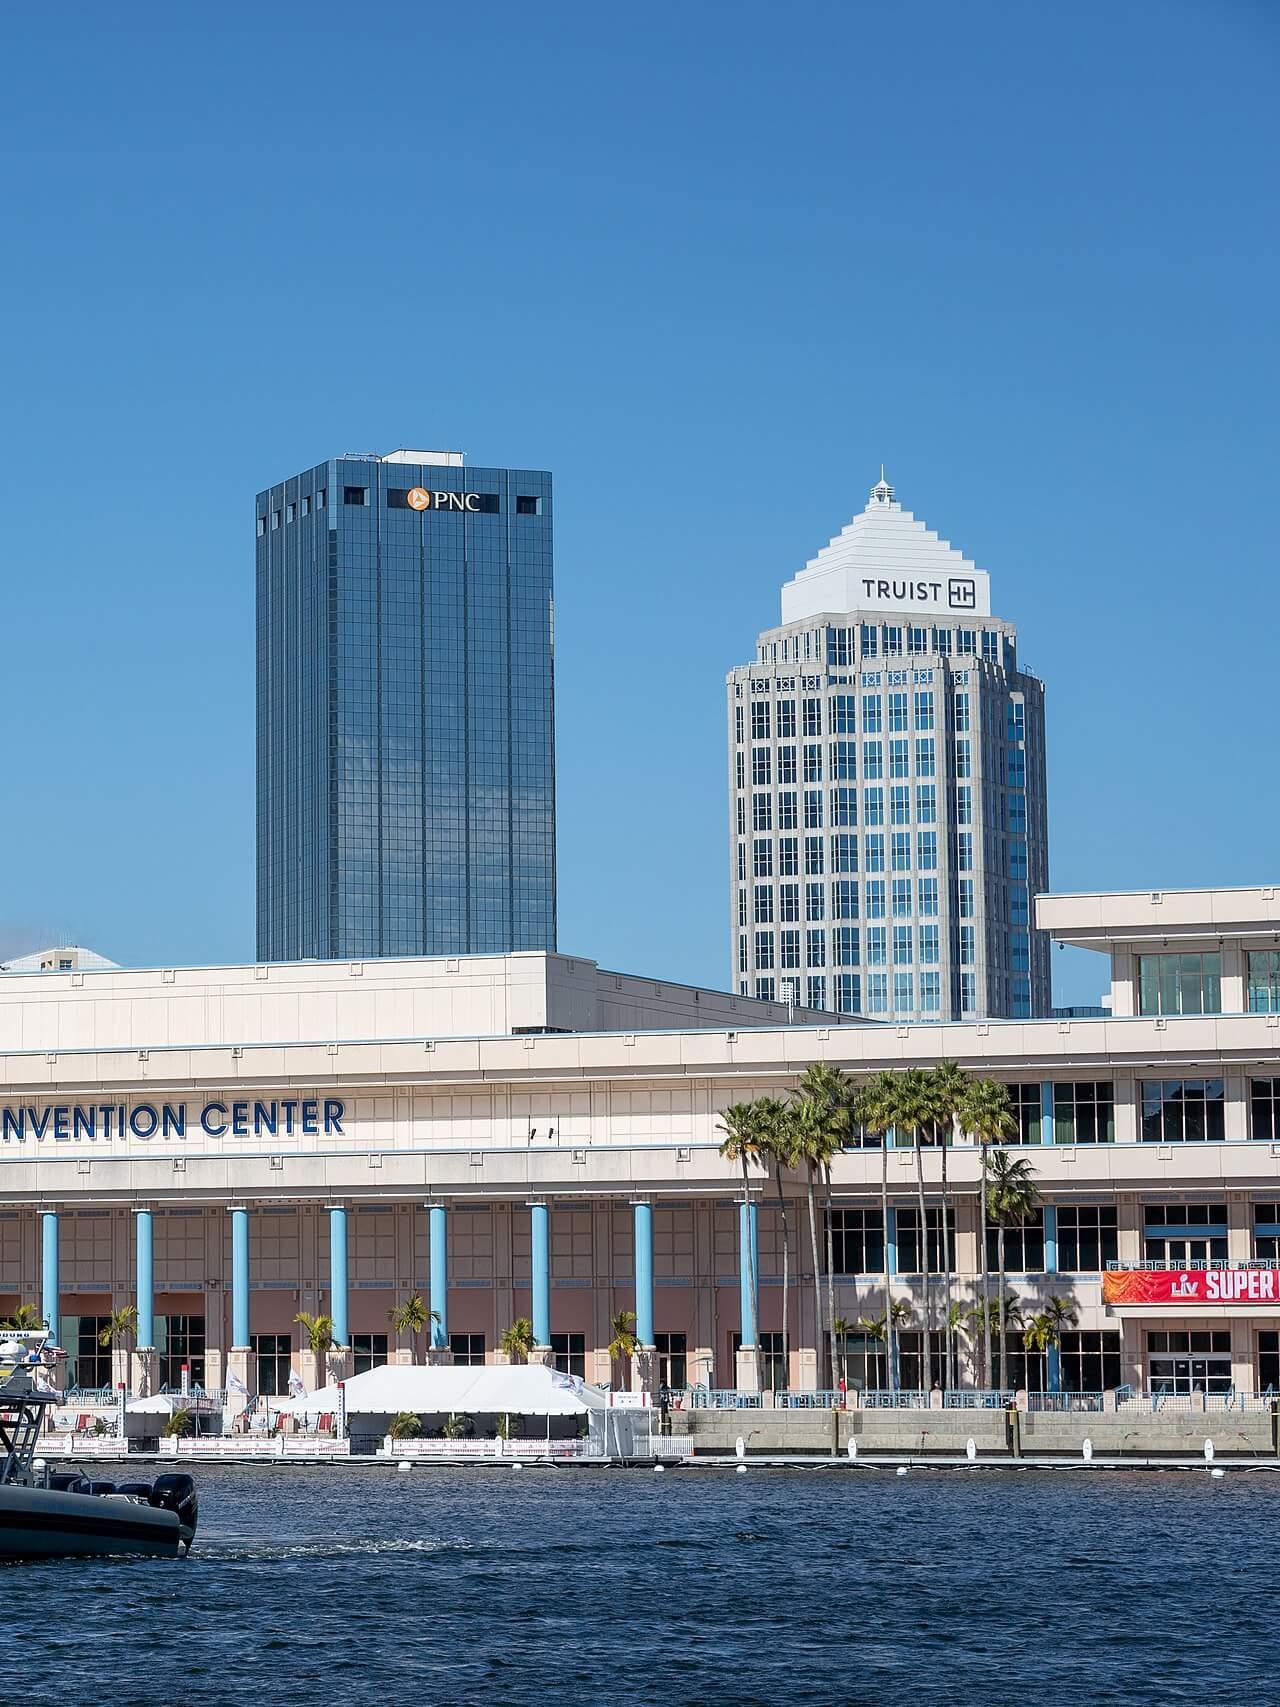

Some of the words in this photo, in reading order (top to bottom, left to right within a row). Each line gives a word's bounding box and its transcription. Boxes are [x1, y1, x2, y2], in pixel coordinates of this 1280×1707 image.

[432, 491, 480, 511] PNC
[862, 579, 942, 601] TRUIST
[200, 1100, 345, 1137] CENTER
[1205, 1271, 1274, 1299] SUPER
